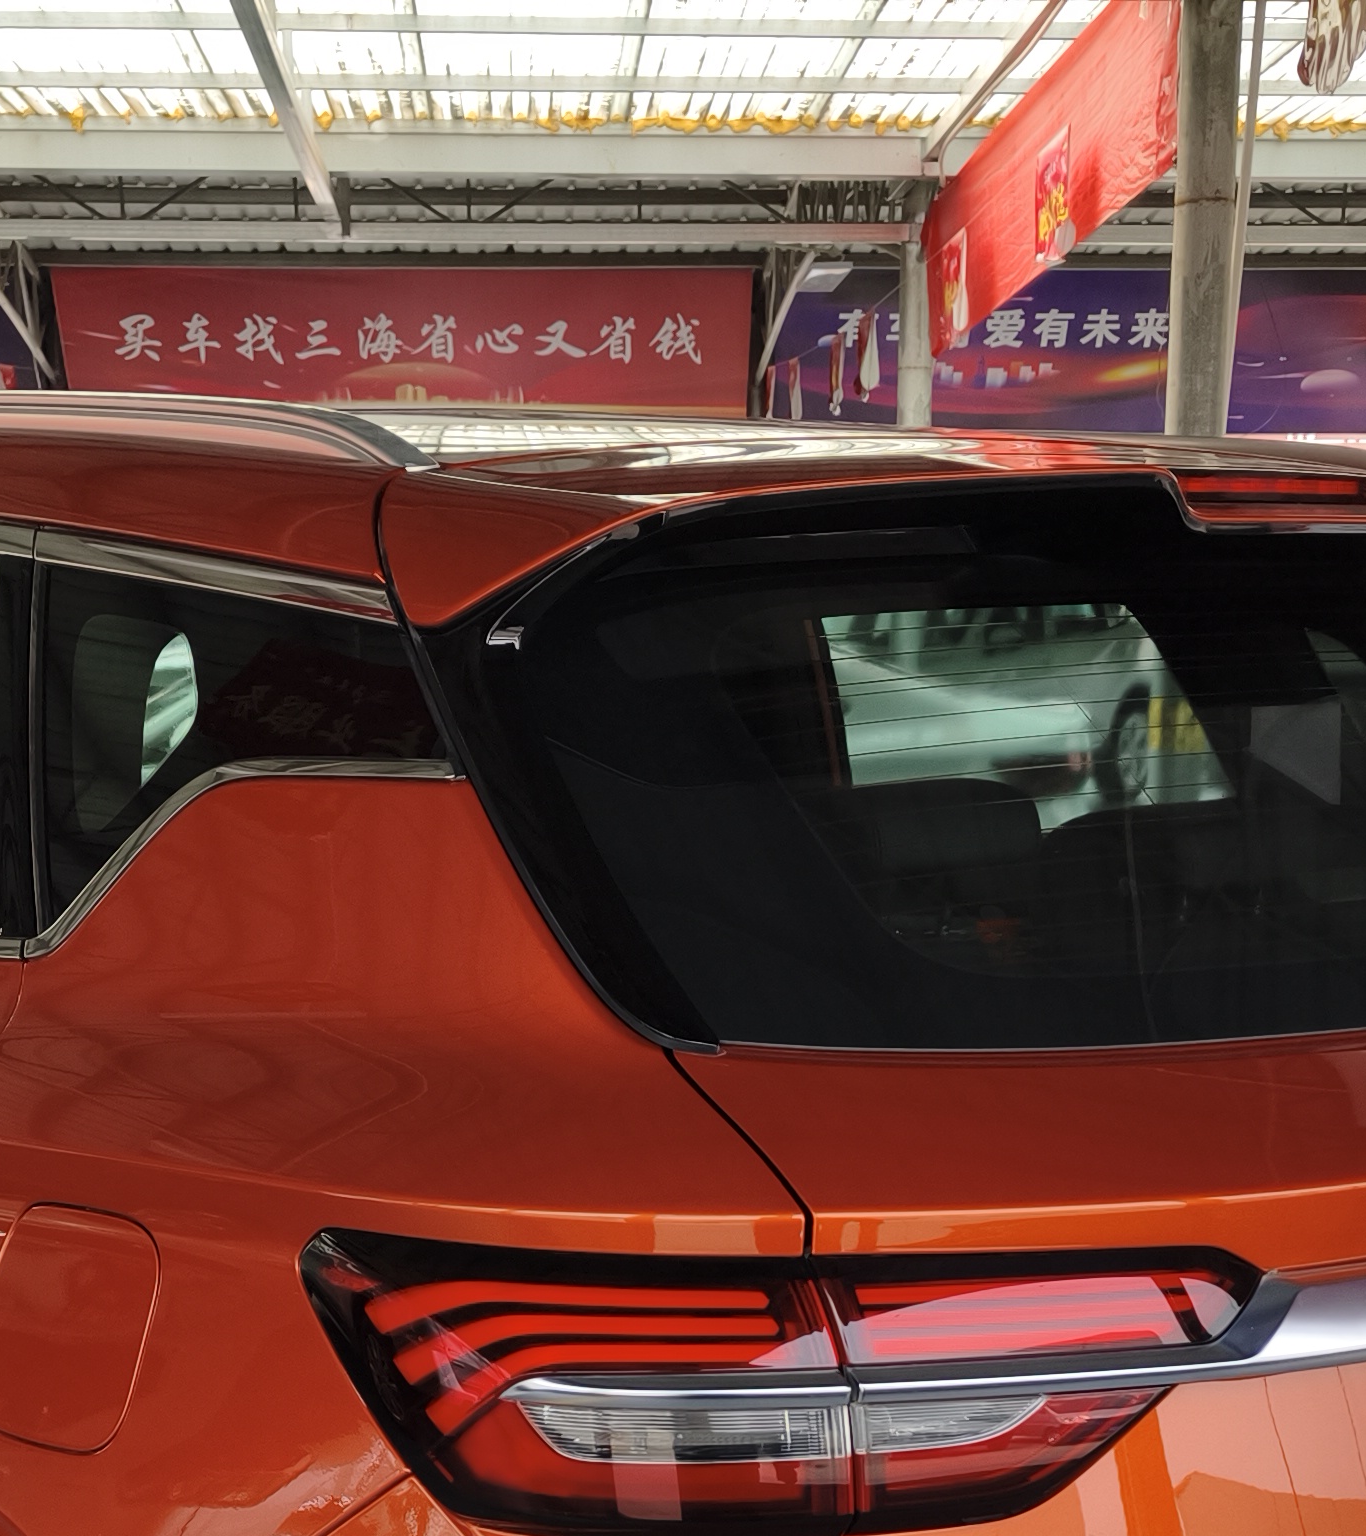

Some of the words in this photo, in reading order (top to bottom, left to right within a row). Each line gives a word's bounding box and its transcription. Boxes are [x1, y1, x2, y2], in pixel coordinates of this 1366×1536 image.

[114, 312, 704, 365] 买车找三海省心又省钱
